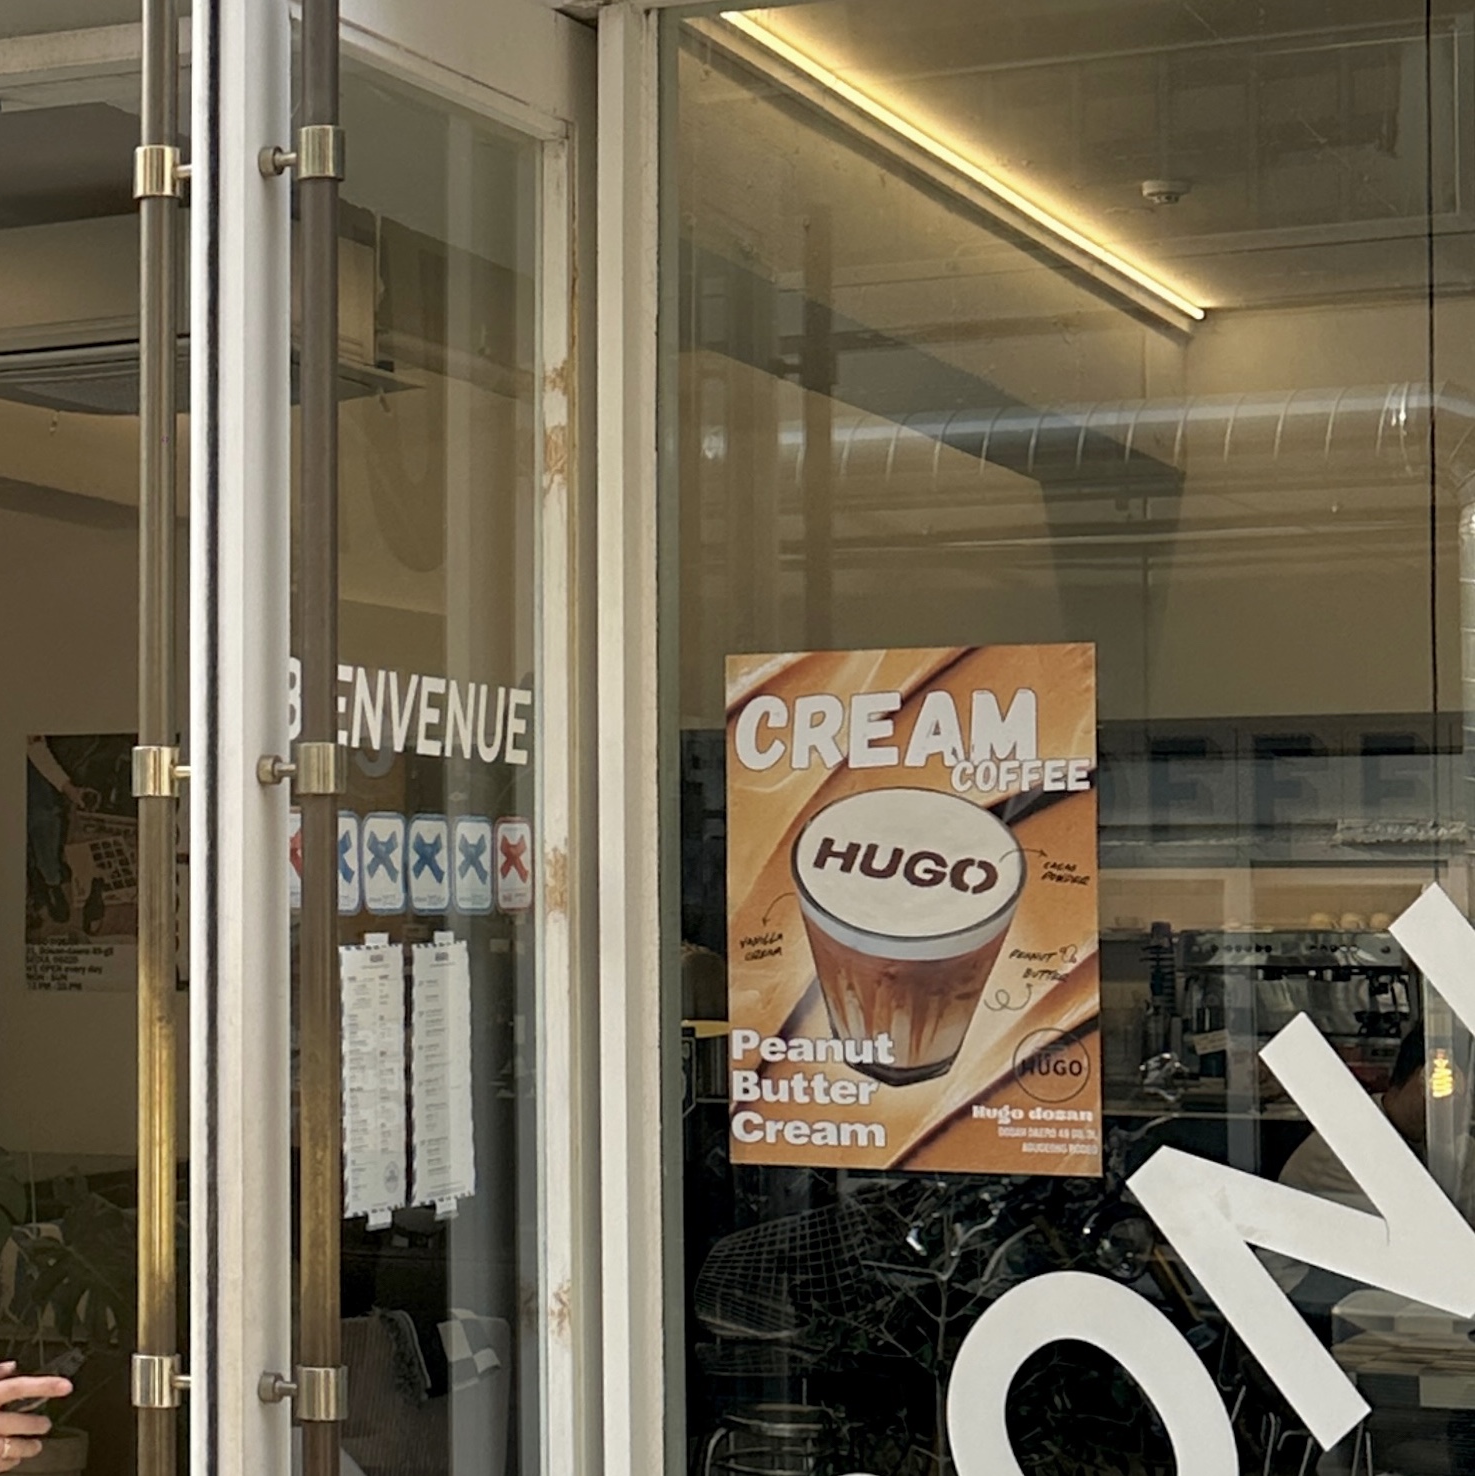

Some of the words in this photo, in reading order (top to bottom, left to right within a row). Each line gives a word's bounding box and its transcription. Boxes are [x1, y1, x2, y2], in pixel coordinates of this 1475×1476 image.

[735, 688, 1038, 771] CREAM
[950, 758, 1092, 792] COFFEE
[812, 837, 998, 895] HUGO
[731, 1028, 896, 1064] Peanut
[731, 1069, 879, 1105] Butter
[730, 1111, 886, 1147] Cream
[972, 1105, 1024, 1124] Hugo
[1028, 1107, 1093, 1122] dosan
